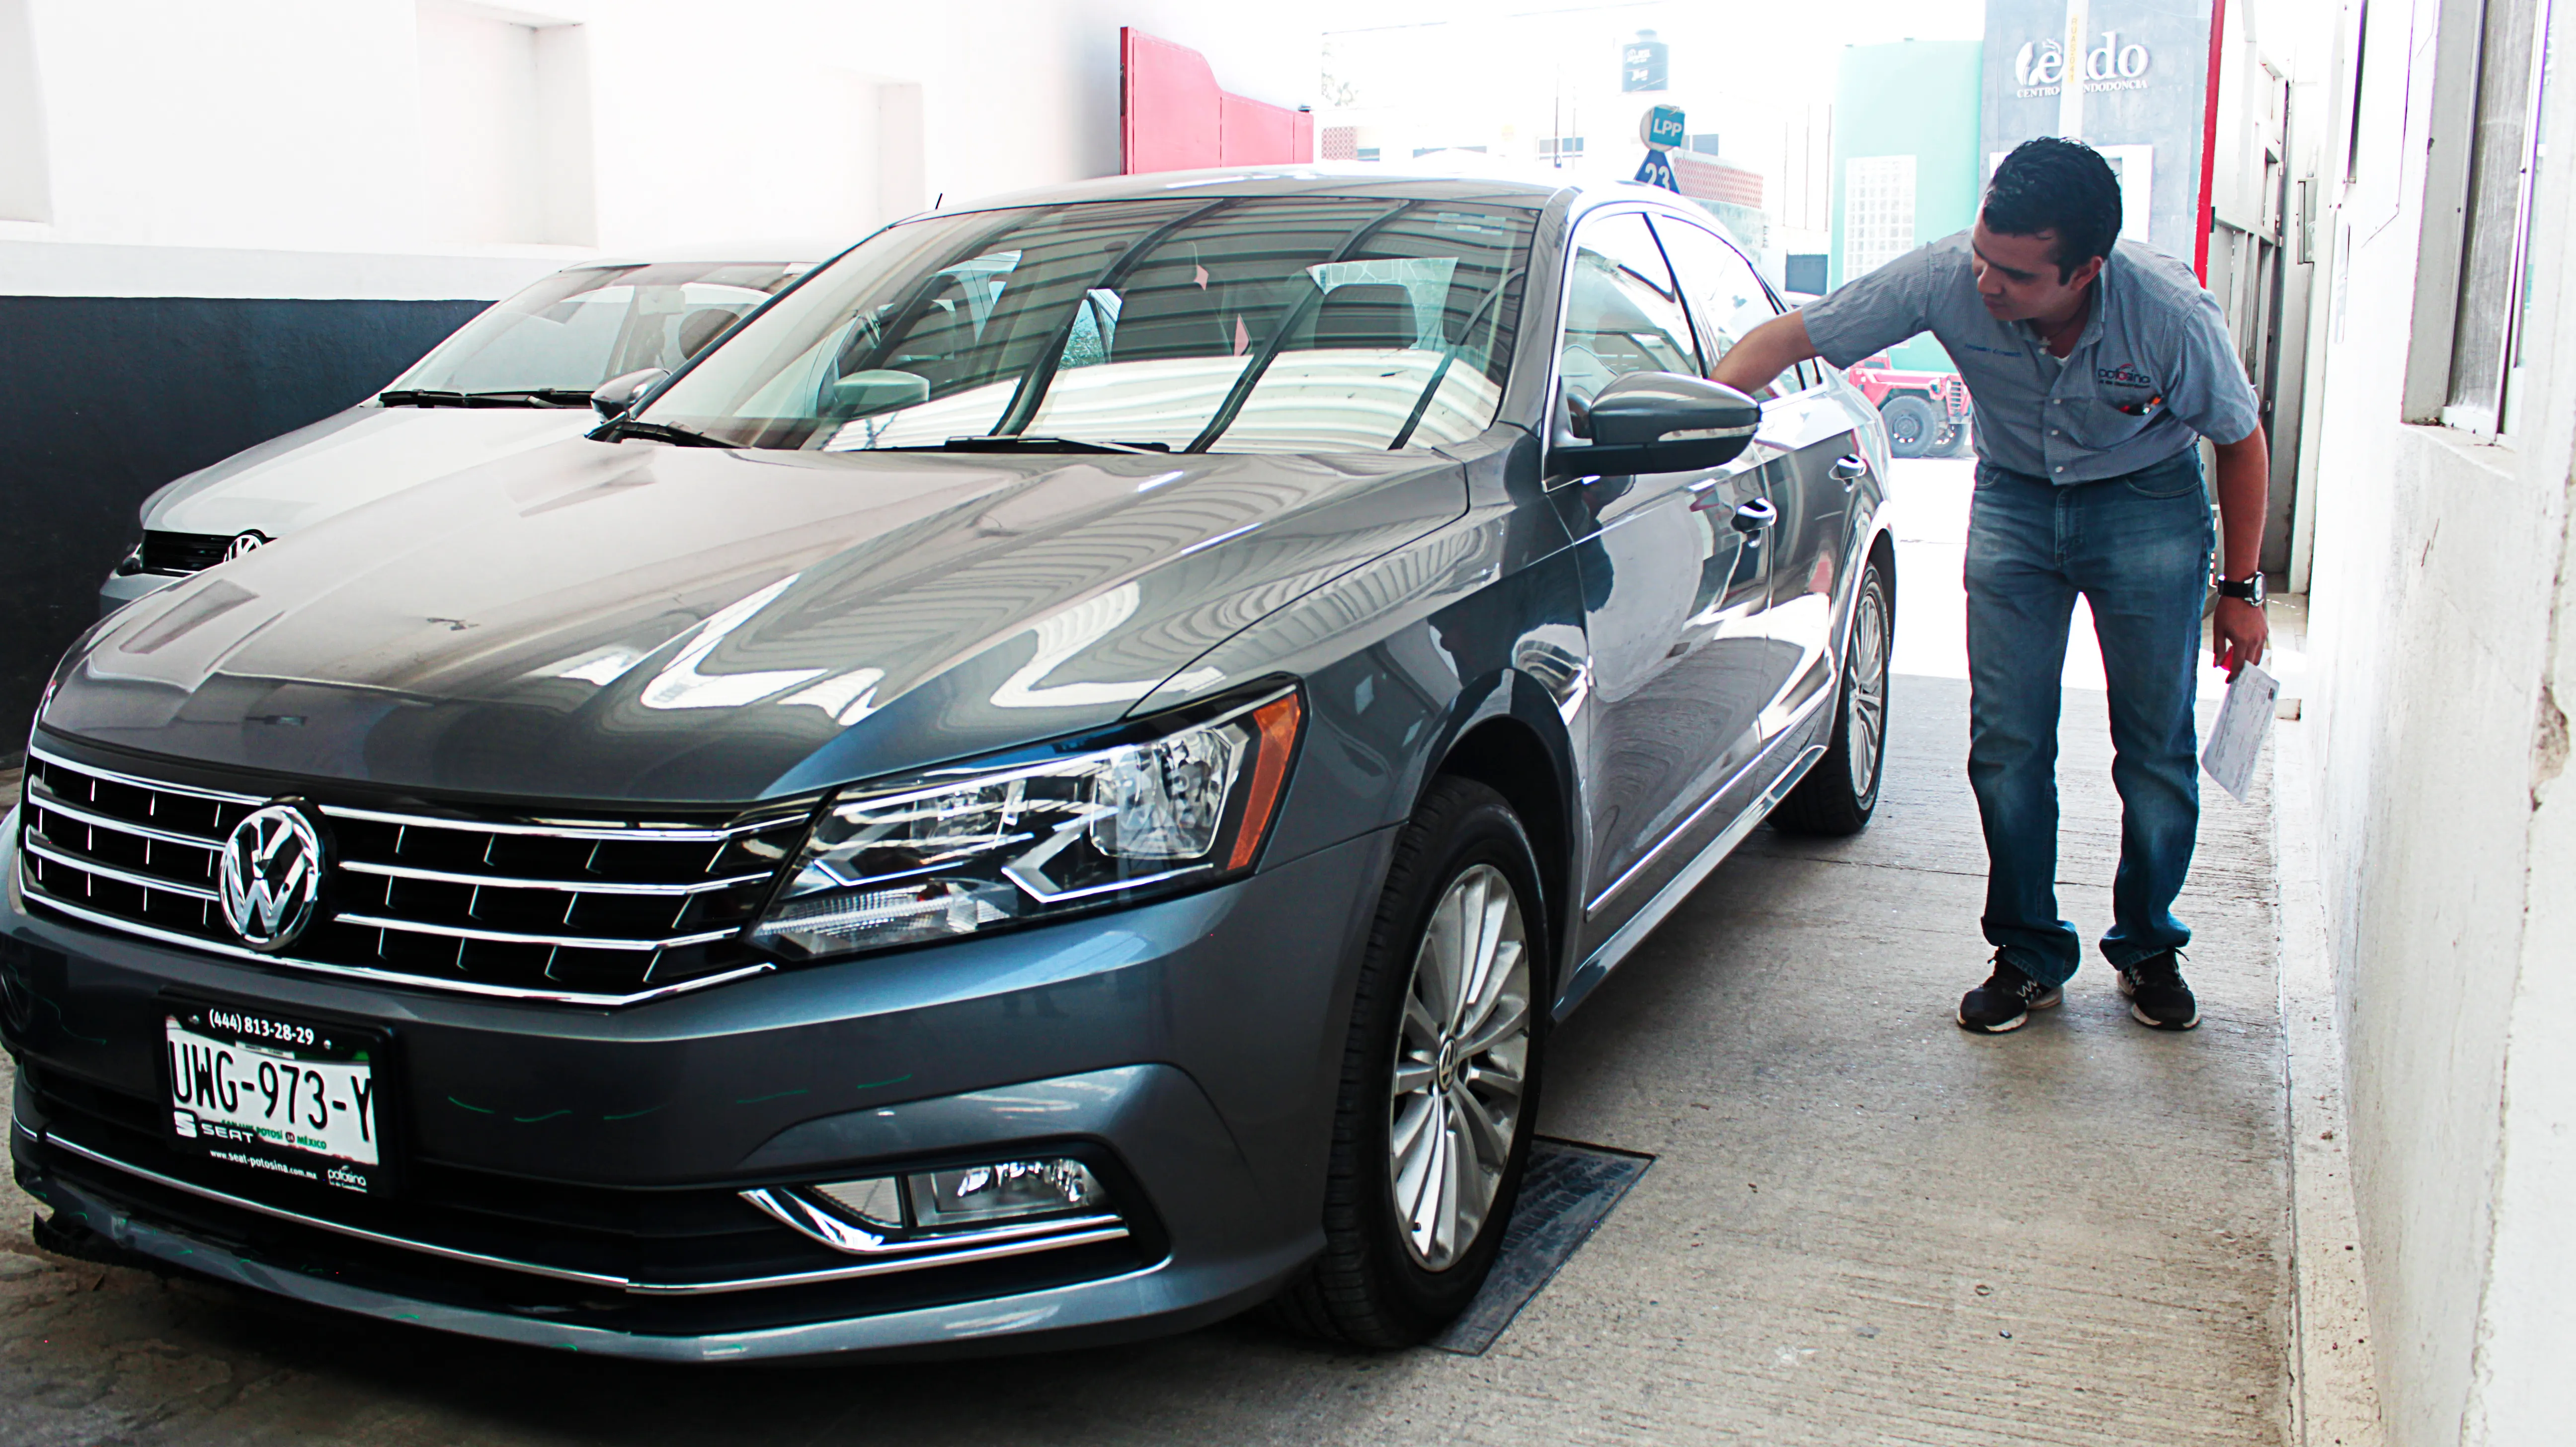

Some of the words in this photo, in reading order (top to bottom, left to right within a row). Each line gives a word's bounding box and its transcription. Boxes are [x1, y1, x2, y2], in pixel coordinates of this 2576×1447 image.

[2016, 86, 2060, 98] CENTRO
[2083, 79, 2148, 93] NDODONCIA
[1653, 118, 1682, 138] LPP
[1645, 162, 1670, 190] 23
[209, 1008, 242, 1034] (444)
[243, 1016, 315, 1045] 813-28-29
[169, 1040, 373, 1142] UWG-973-Y
[201, 1123, 254, 1143] SEAT
[256, 1126, 283, 1139] POTOSÍ
[297, 1135, 327, 1150] MÉXICO
[210, 1149, 318, 1180] www.seat-potosina.com.mx
[327, 1168, 367, 1187] potosina
